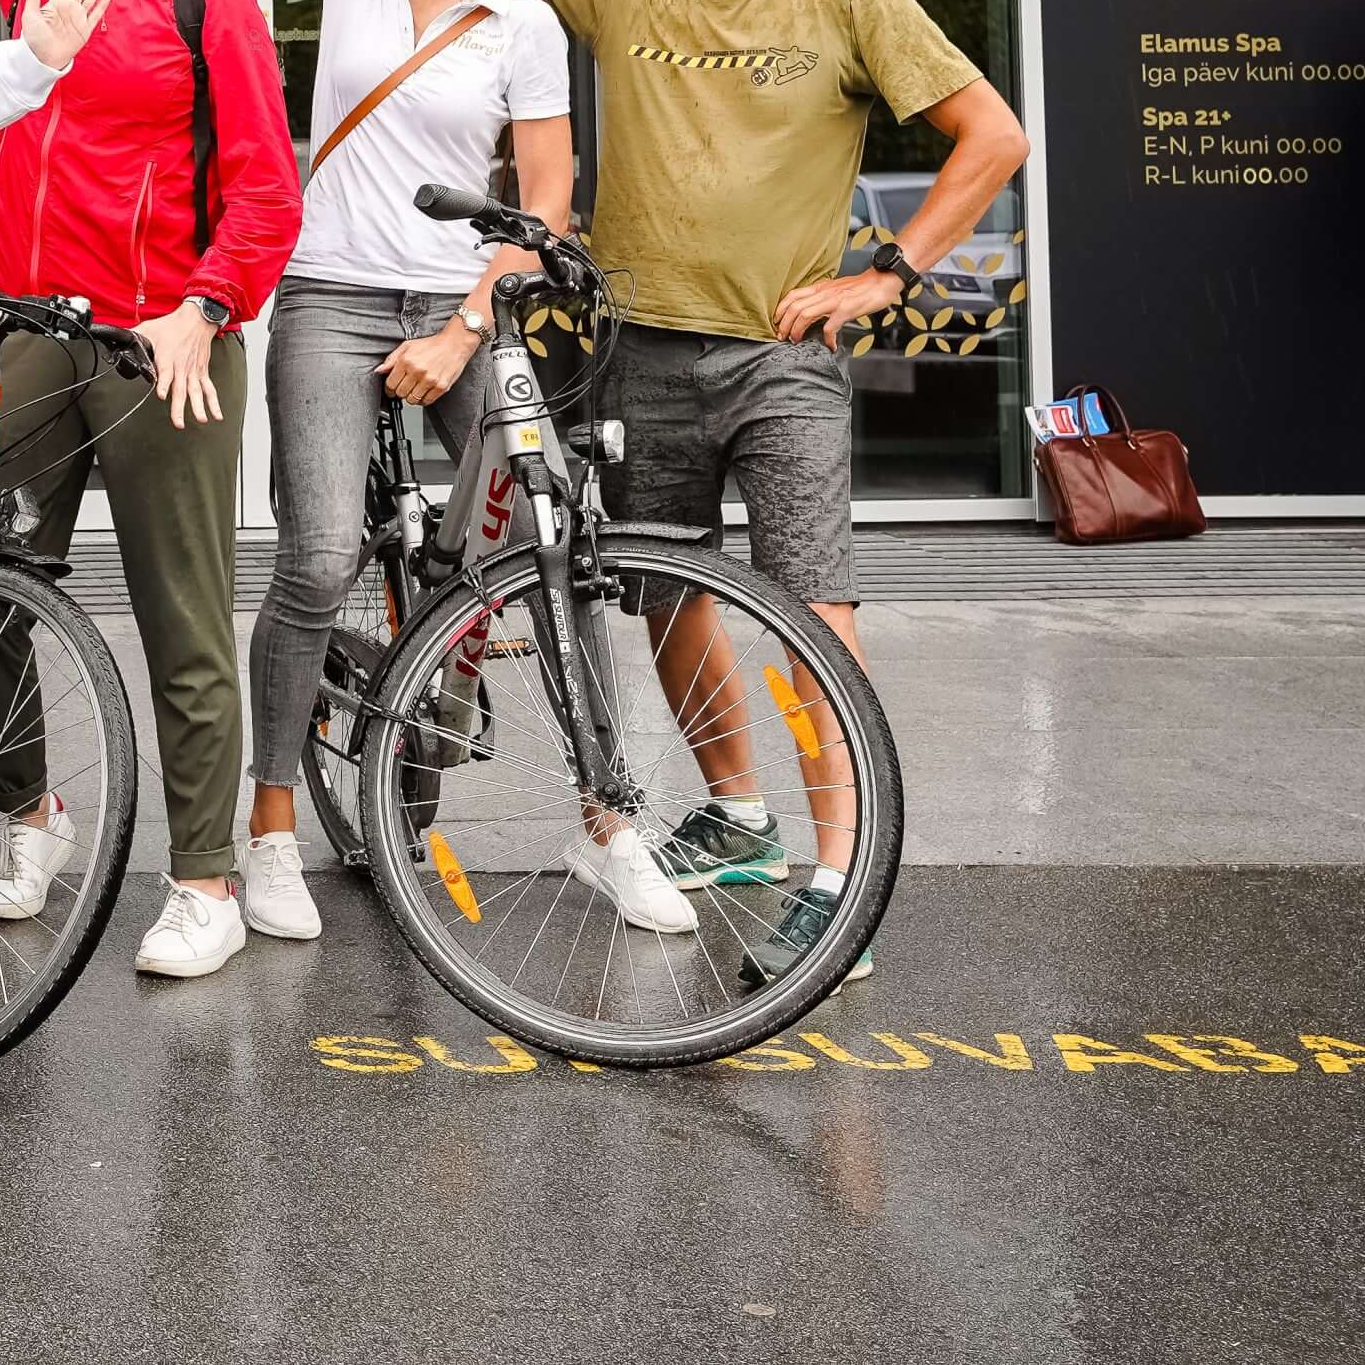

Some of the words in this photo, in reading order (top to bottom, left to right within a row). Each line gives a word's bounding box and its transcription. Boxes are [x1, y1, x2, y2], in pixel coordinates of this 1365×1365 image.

[1140, 33, 1230, 53] Elamus
[1236, 33, 1282, 57] Spa
[1141, 63, 1176, 88] Iga
[1184, 62, 1240, 87] päev
[1246, 61, 1294, 82] kuni
[1142, 107, 1188, 130] Spa
[1194, 109, 1232, 126] 21+
[1144, 136, 1193, 157] E-N,
[1200, 136, 1215, 155] P
[1221, 135, 1269, 155] kuni
[1145, 165, 1186, 185] R-L
[1192, 164, 1239, 185] kuni
